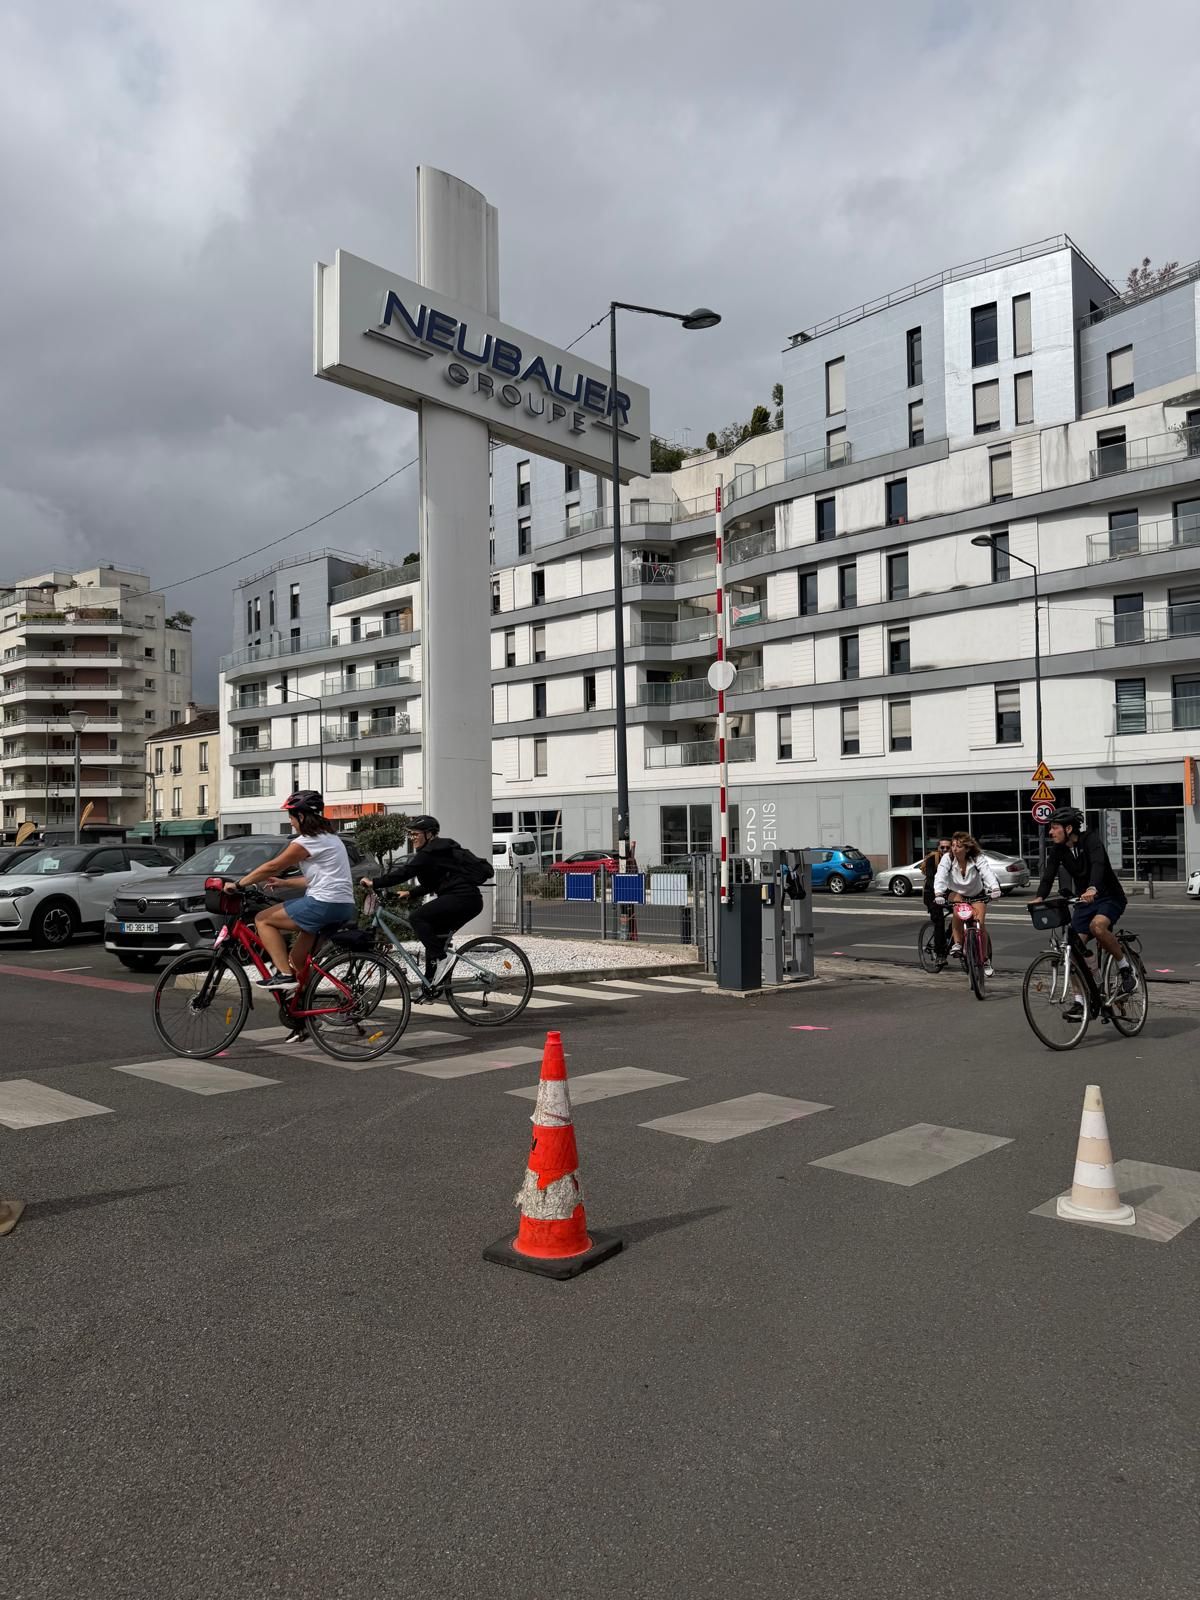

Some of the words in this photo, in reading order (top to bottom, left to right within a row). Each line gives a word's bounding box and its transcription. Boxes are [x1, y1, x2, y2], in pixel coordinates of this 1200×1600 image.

[380, 289, 632, 425] NEUBAUER
[446, 362, 587, 434] GROUPE
[1037, 807, 1051, 817] 30
